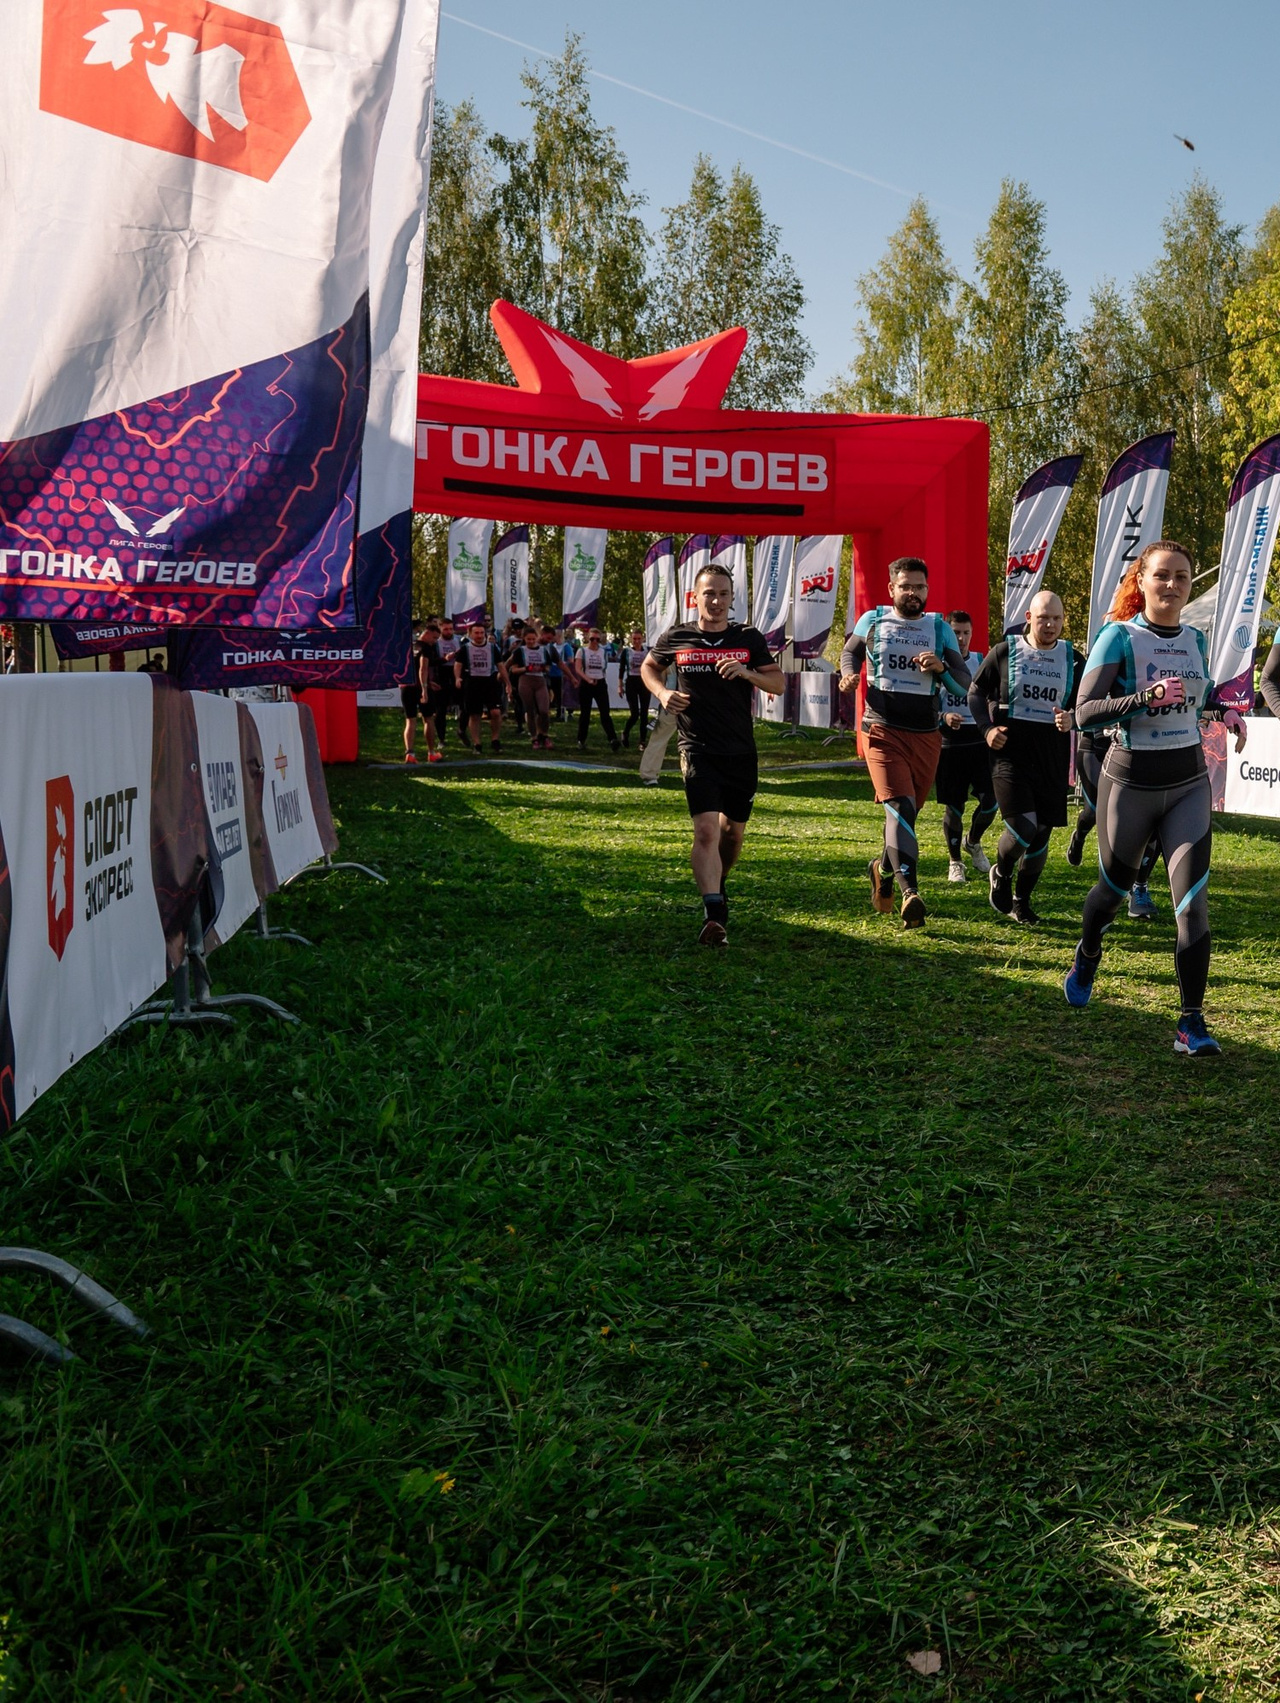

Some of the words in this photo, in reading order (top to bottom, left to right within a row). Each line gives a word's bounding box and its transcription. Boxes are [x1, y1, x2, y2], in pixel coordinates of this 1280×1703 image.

[416, 419, 610, 481] ГОНКА
[630, 443, 828, 492] ГЕРОЕВ
[109, 539, 135, 548] ЛИГА
[0, 549, 124, 582] ГОНКА
[136, 559, 257, 586] ГЕРОЕВ
[895, 637, 930, 648] РТК-ЦОД
[222, 649, 287, 666] ГОНКА
[291, 648, 364, 661] ГЕРОЕВ
[678, 651, 748, 662] ИНСТРУКТОР
[888, 654, 918, 671] 584
[1030, 669, 1061, 679] РТК-ЦОД
[1160, 669, 1202, 680] РТК-ЦОД
[947, 695, 968, 707] 584
[1022, 684, 1058, 702] 5840
[84, 787, 138, 867] СПОРТ
[85, 857, 133, 921] ЭКСПРЕСС
